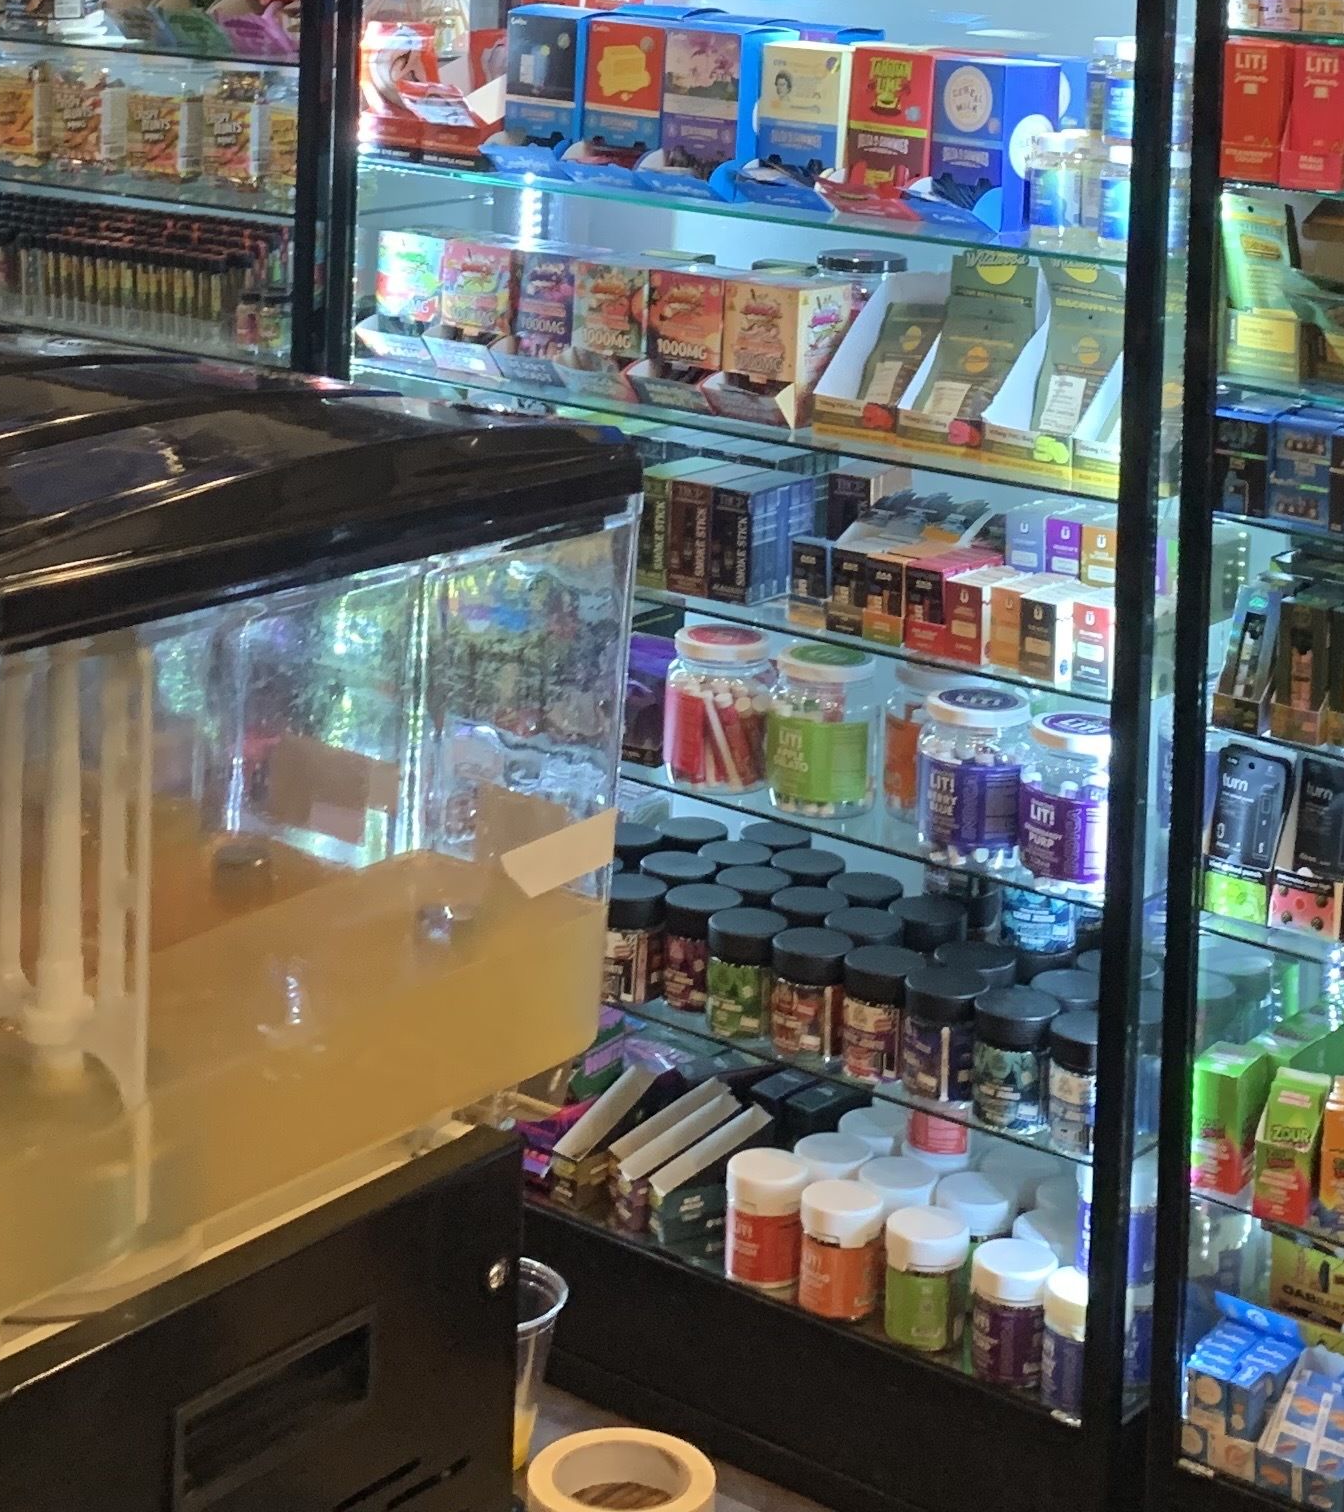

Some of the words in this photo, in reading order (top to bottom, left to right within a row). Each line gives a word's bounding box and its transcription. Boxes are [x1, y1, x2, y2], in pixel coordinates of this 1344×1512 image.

[1235, 52, 1268, 72] LIT!
[1306, 55, 1339, 75] LIT!
[521, 317, 566, 336] 1000MG
[657, 338, 707, 360] 1000MG
[930, 770, 955, 793] LIT!
[1030, 803, 1055, 826] LIT!
